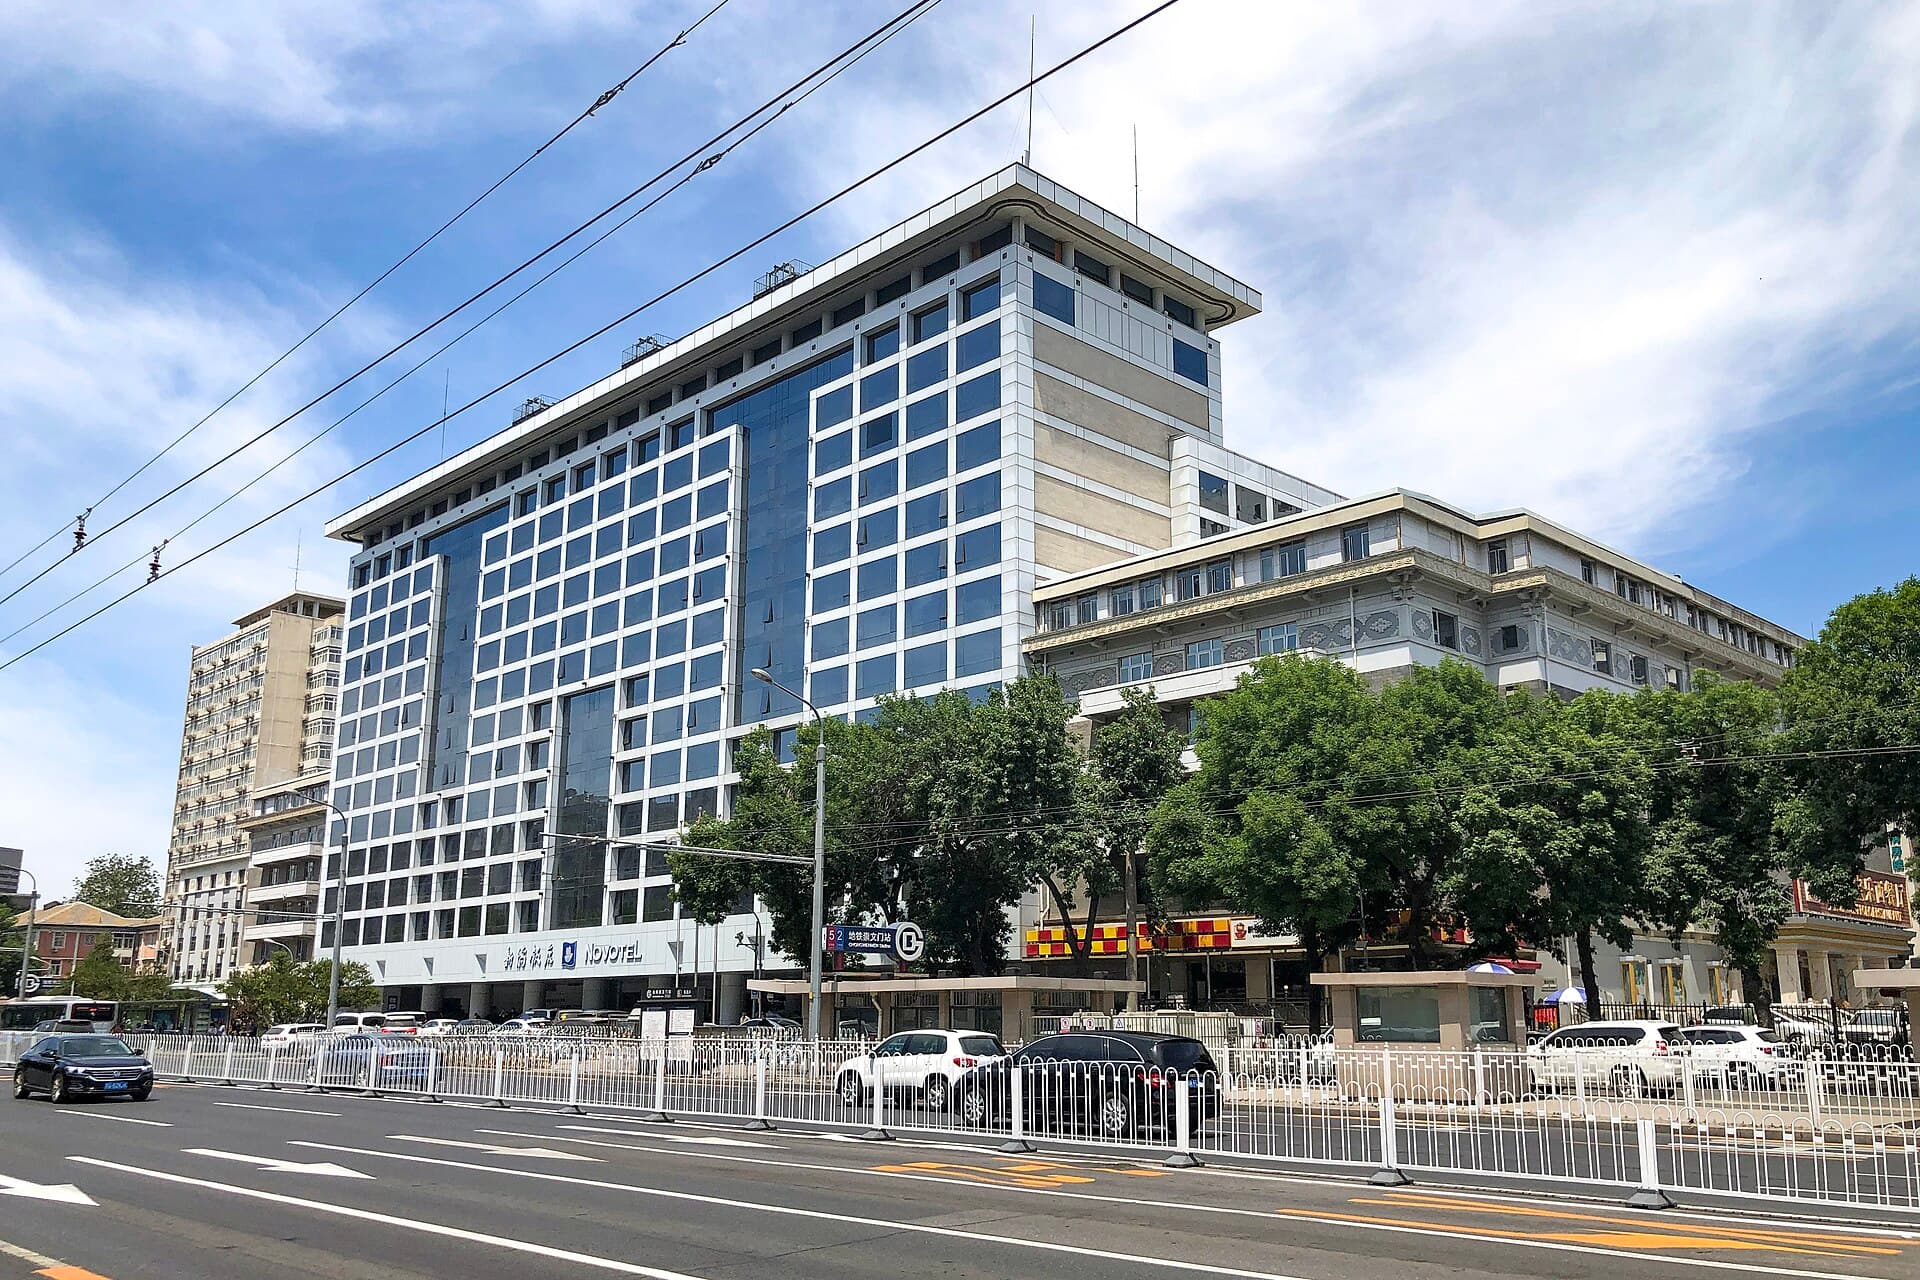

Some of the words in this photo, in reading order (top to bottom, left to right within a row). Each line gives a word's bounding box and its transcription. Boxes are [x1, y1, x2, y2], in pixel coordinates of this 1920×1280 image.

[829, 930, 835, 940] 5
[837, 930, 843, 940] 2
[584, 939, 643, 966] NOVOTEL
